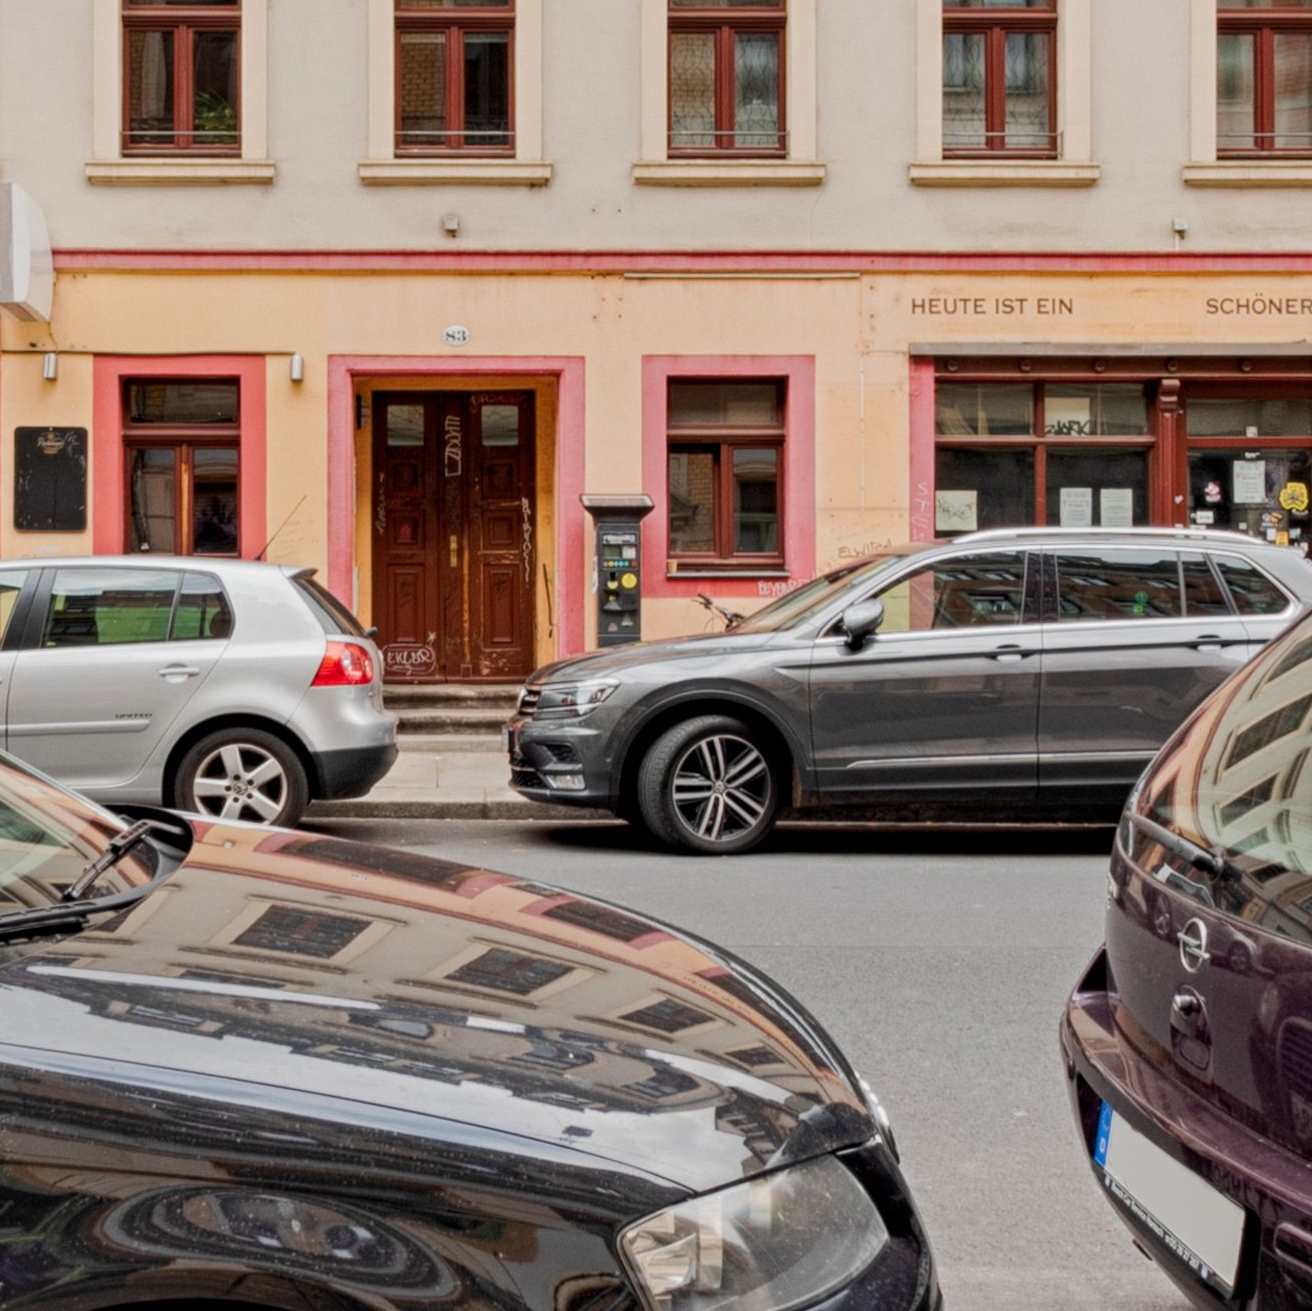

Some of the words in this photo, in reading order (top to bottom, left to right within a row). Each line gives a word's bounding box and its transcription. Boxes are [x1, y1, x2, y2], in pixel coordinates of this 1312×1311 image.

[911, 298, 986, 315] HEUTE
[995, 298, 1028, 315] IST
[1036, 298, 1074, 315] EIN
